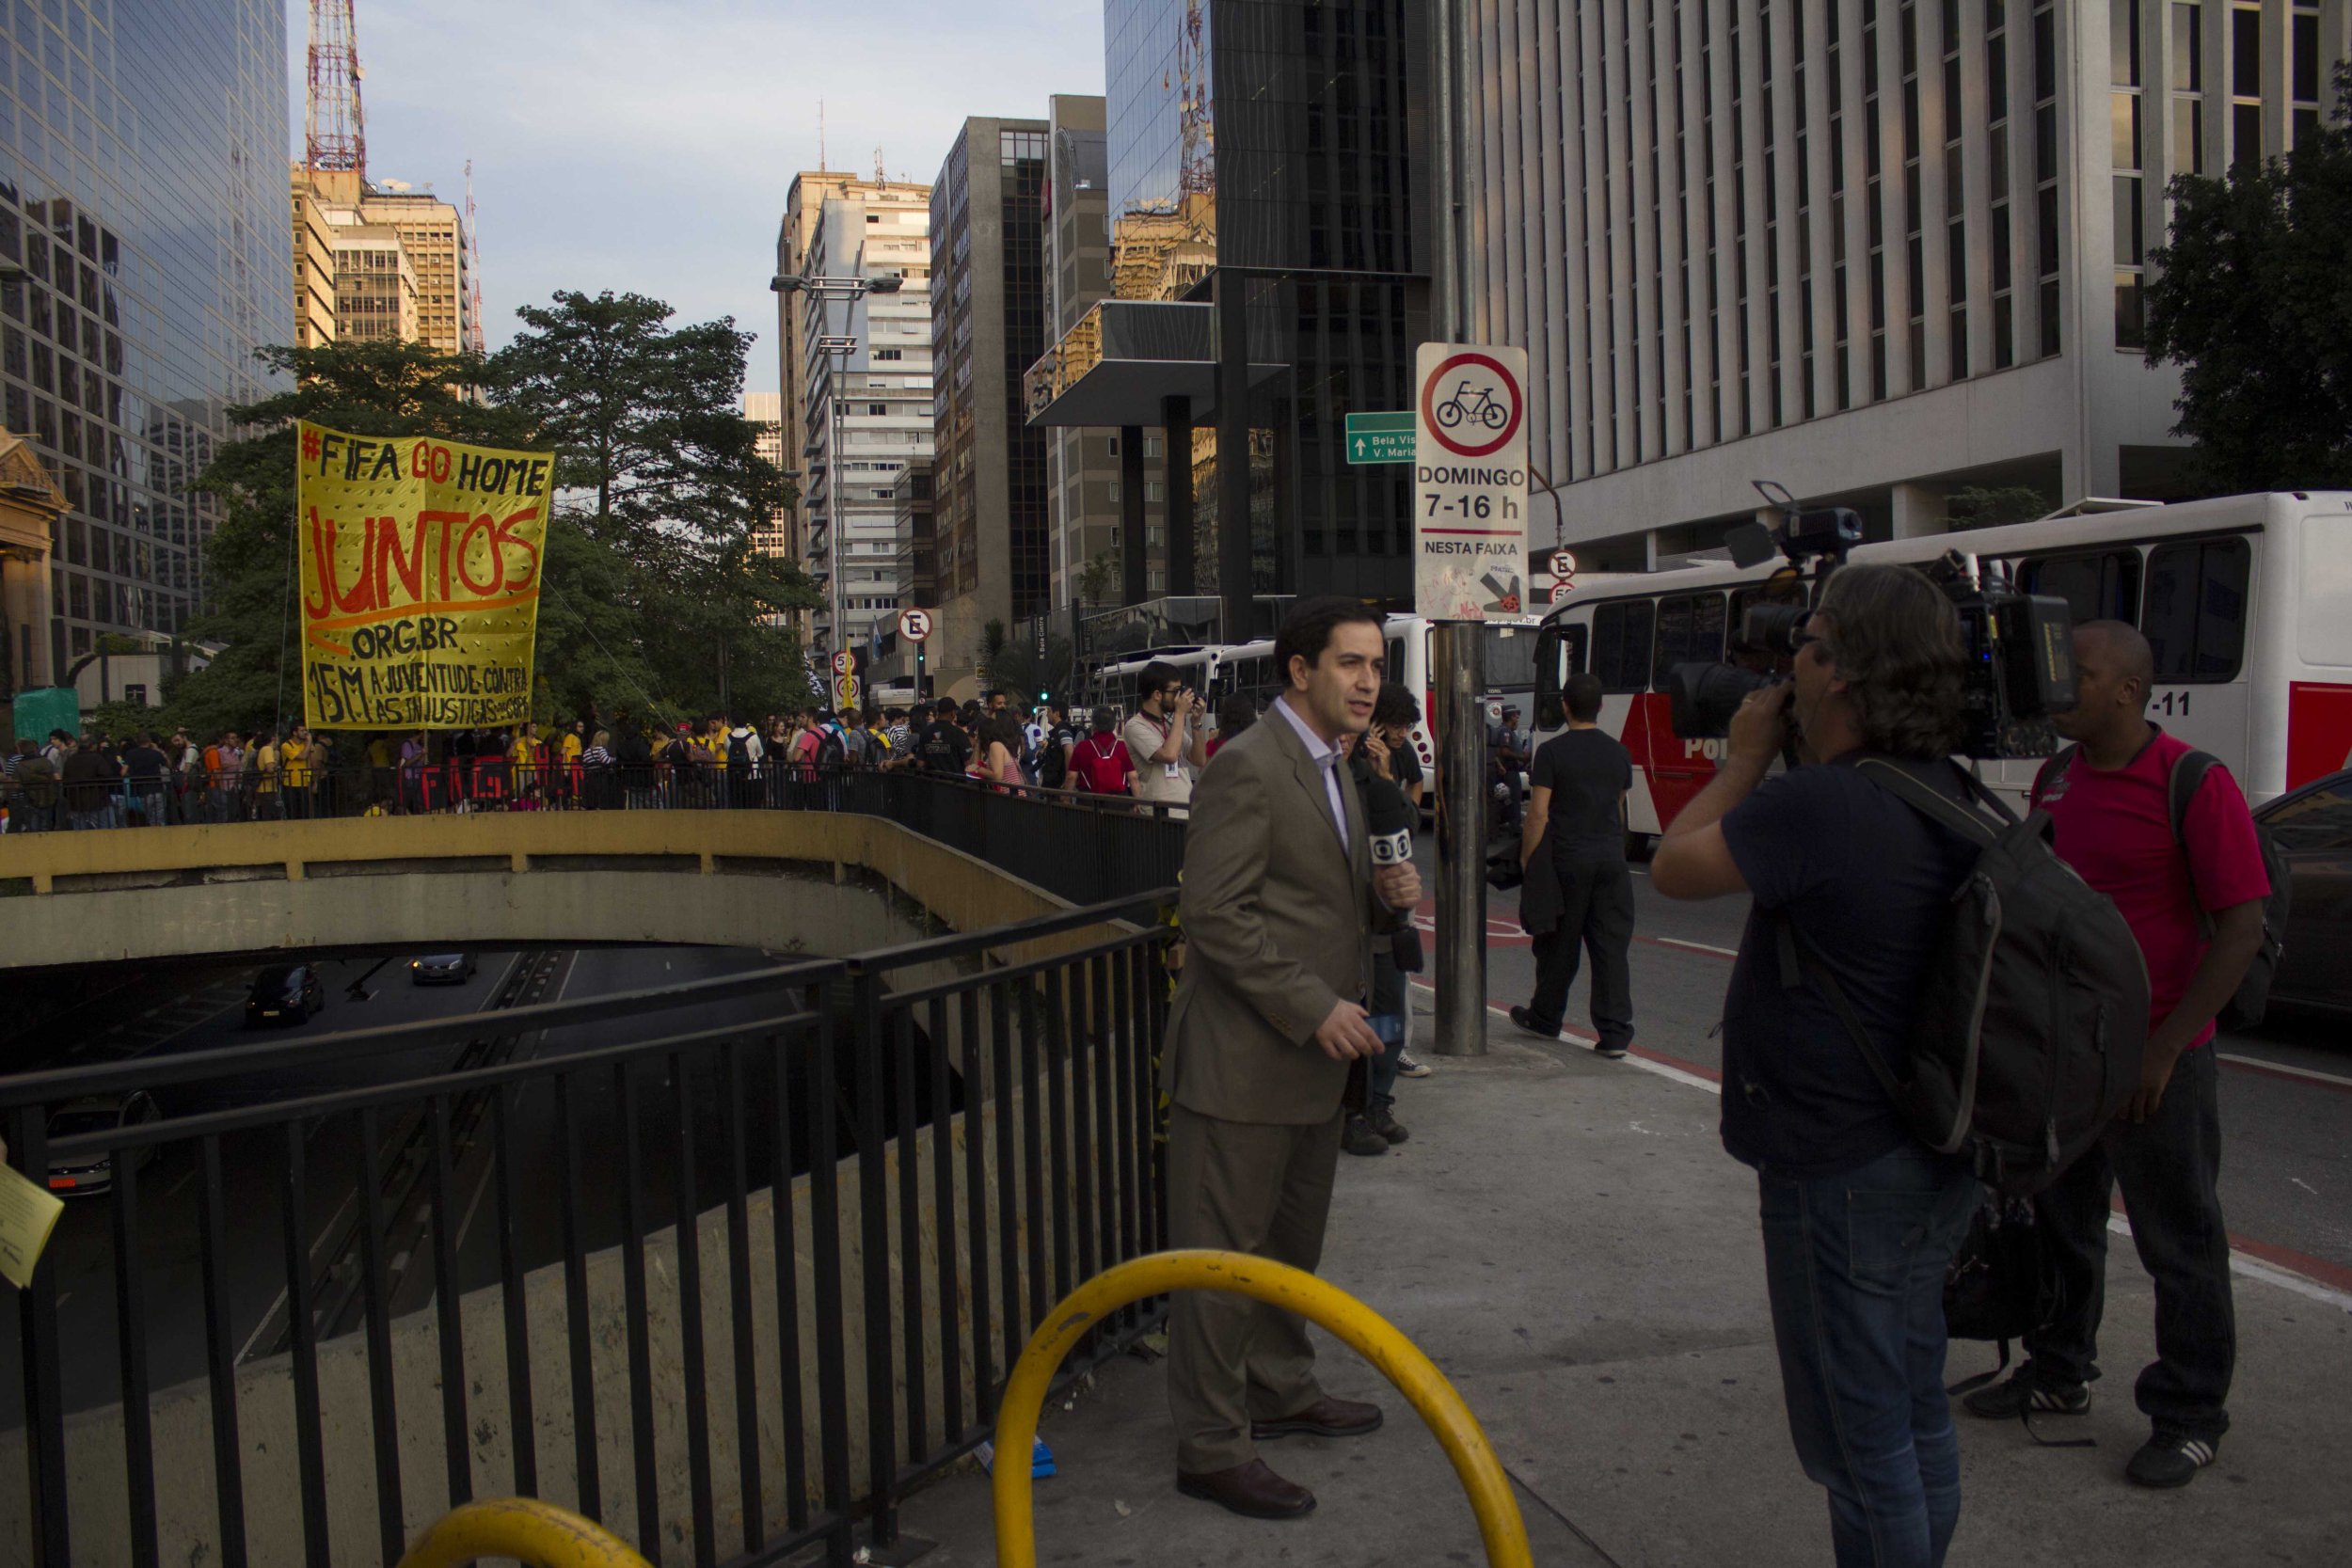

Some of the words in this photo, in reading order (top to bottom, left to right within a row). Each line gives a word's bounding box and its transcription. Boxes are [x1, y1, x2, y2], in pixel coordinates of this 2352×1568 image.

[1372, 436, 1395, 446] Bela
[1374, 449, 1385, 457] V.
[412, 440, 452, 483] GO
[457, 452, 548, 496] HOME
[1418, 466, 1524, 486] DOMINGO
[1425, 494, 1490, 518] 7-16
[1502, 496, 1518, 519] h
[1425, 542, 1471, 555] NESTA
[1476, 543, 1518, 555] FAIXA
[304, 505, 539, 620] JUNTOS
[350, 617, 458, 661] .ORG.BR
[371, 666, 382, 695] A
[386, 661, 480, 695] JUVENTUDE
[483, 666, 528, 694] CONTRA
[309, 661, 373, 723] 15M
[377, 697, 404, 724] AS
